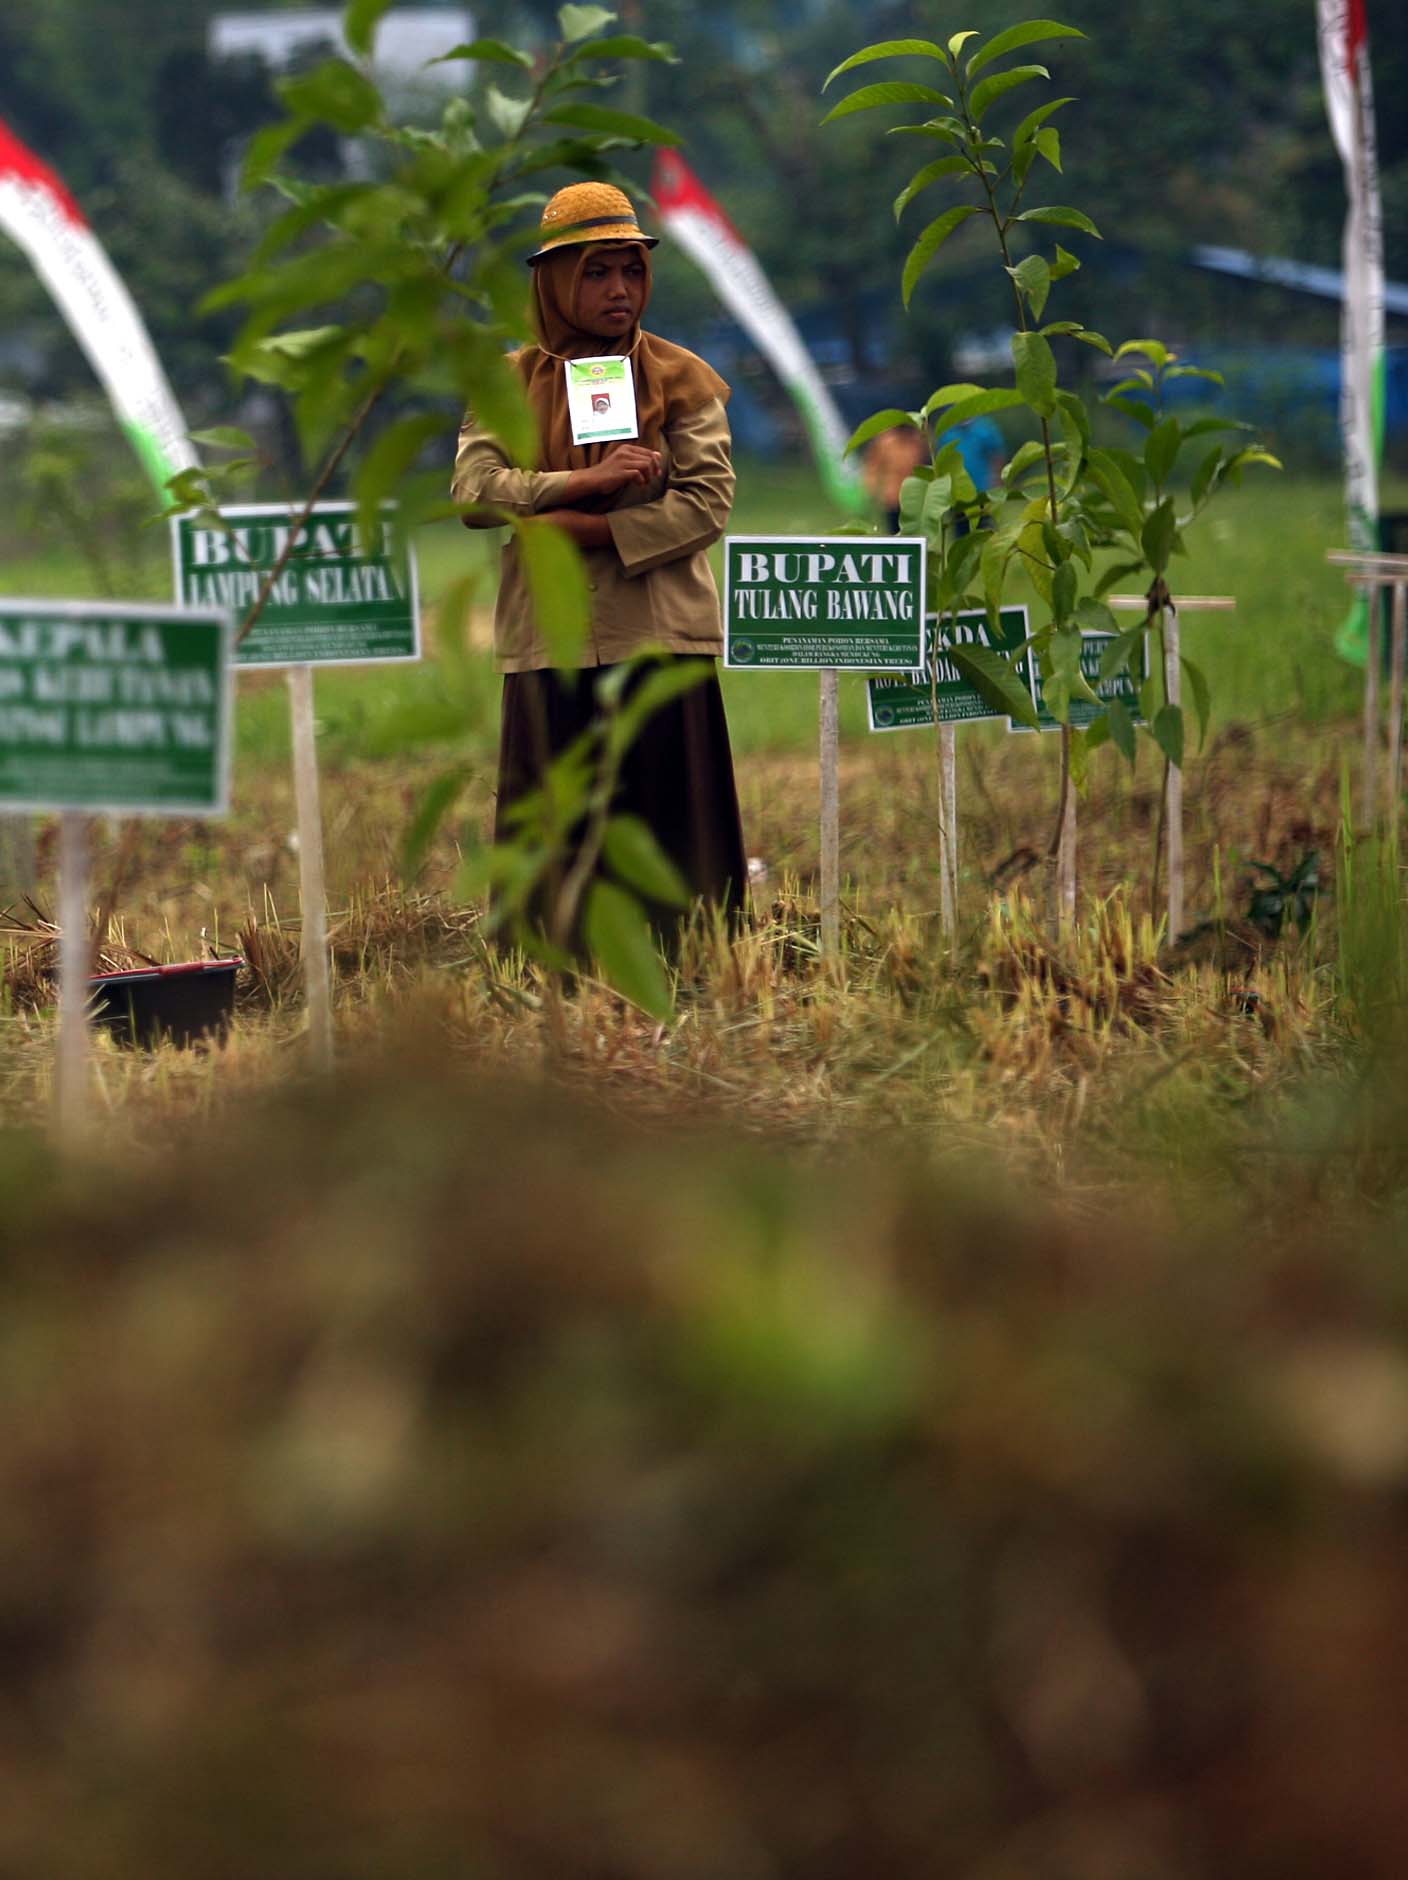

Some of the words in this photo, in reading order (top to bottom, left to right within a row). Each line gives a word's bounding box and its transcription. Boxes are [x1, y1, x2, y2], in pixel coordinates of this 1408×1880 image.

[191, 522, 391, 564] BUPATI
[736, 552, 913, 583] BUPATI
[734, 588, 818, 621] TULANG
[826, 589, 913, 621] BAWANG
